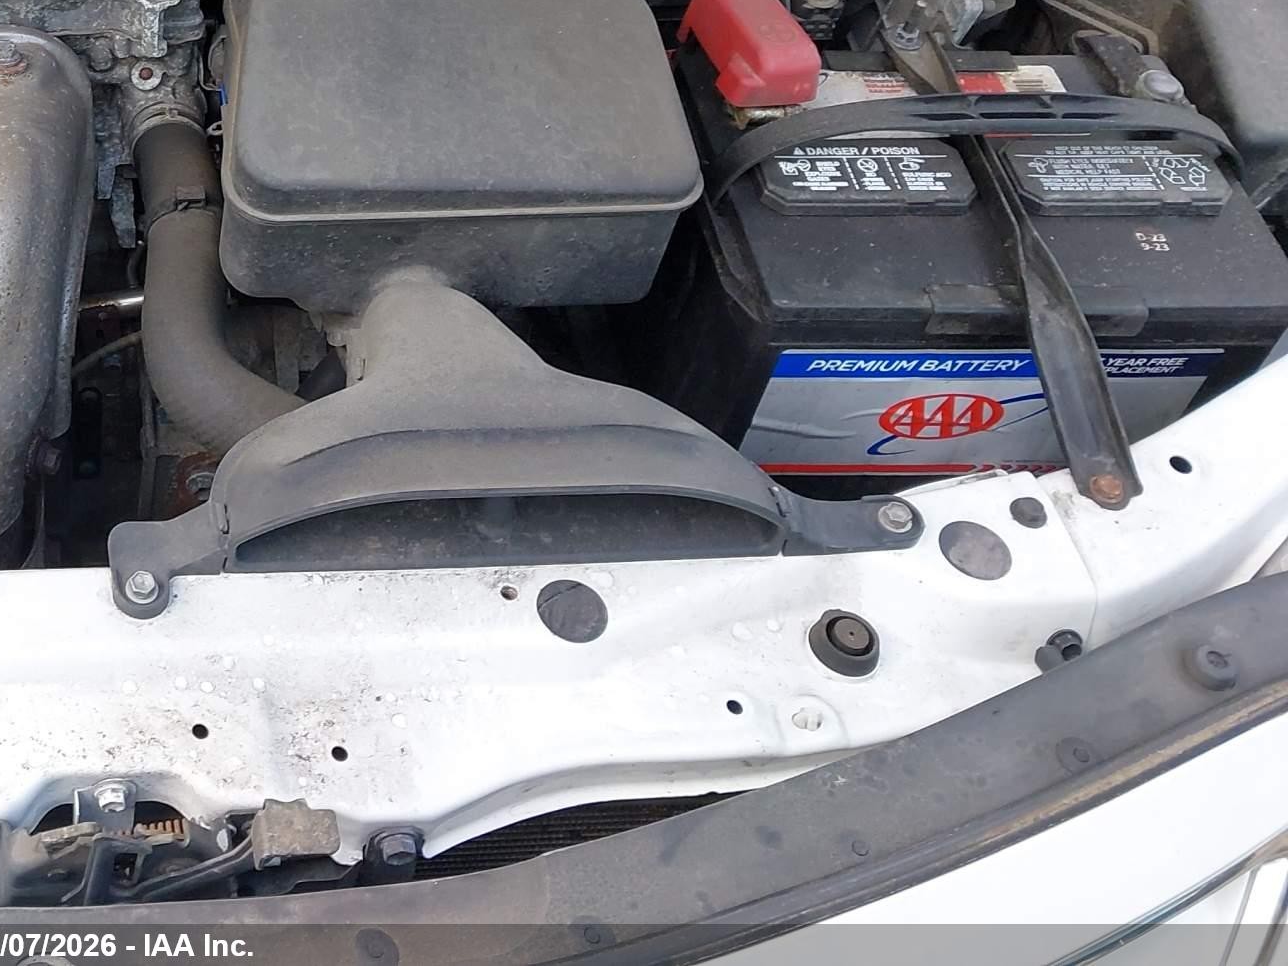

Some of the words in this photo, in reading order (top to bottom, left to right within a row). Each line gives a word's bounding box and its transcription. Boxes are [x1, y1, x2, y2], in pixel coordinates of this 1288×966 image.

[806, 146, 859, 155] DANGER
[870, 146, 921, 155] POISON
[806, 359, 919, 372] PREMIUM
[918, 359, 1032, 372] BATTERY
[1106, 357, 1146, 366] YEAR
[1146, 357, 1189, 366] FREE
[886, 394, 998, 439] AAA
